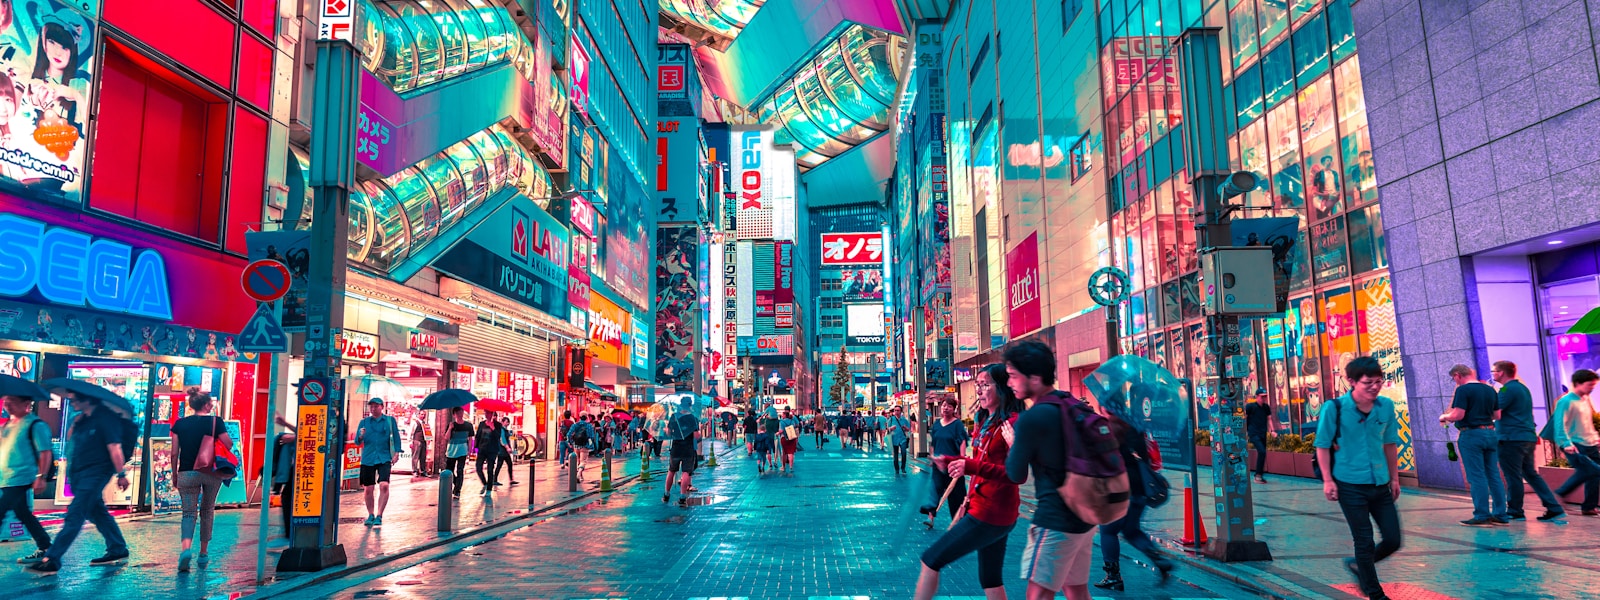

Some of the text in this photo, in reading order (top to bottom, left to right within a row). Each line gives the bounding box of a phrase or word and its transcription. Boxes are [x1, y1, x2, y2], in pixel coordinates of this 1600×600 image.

[0, 212, 174, 321] SEGA
[532, 219, 568, 271] LABI
[781, 244, 792, 289] Duty Free
[1011, 267, 1032, 307] atré
[419, 333, 438, 349] LABI
[300, 413, 318, 513] 路上喫煙禁止です。
